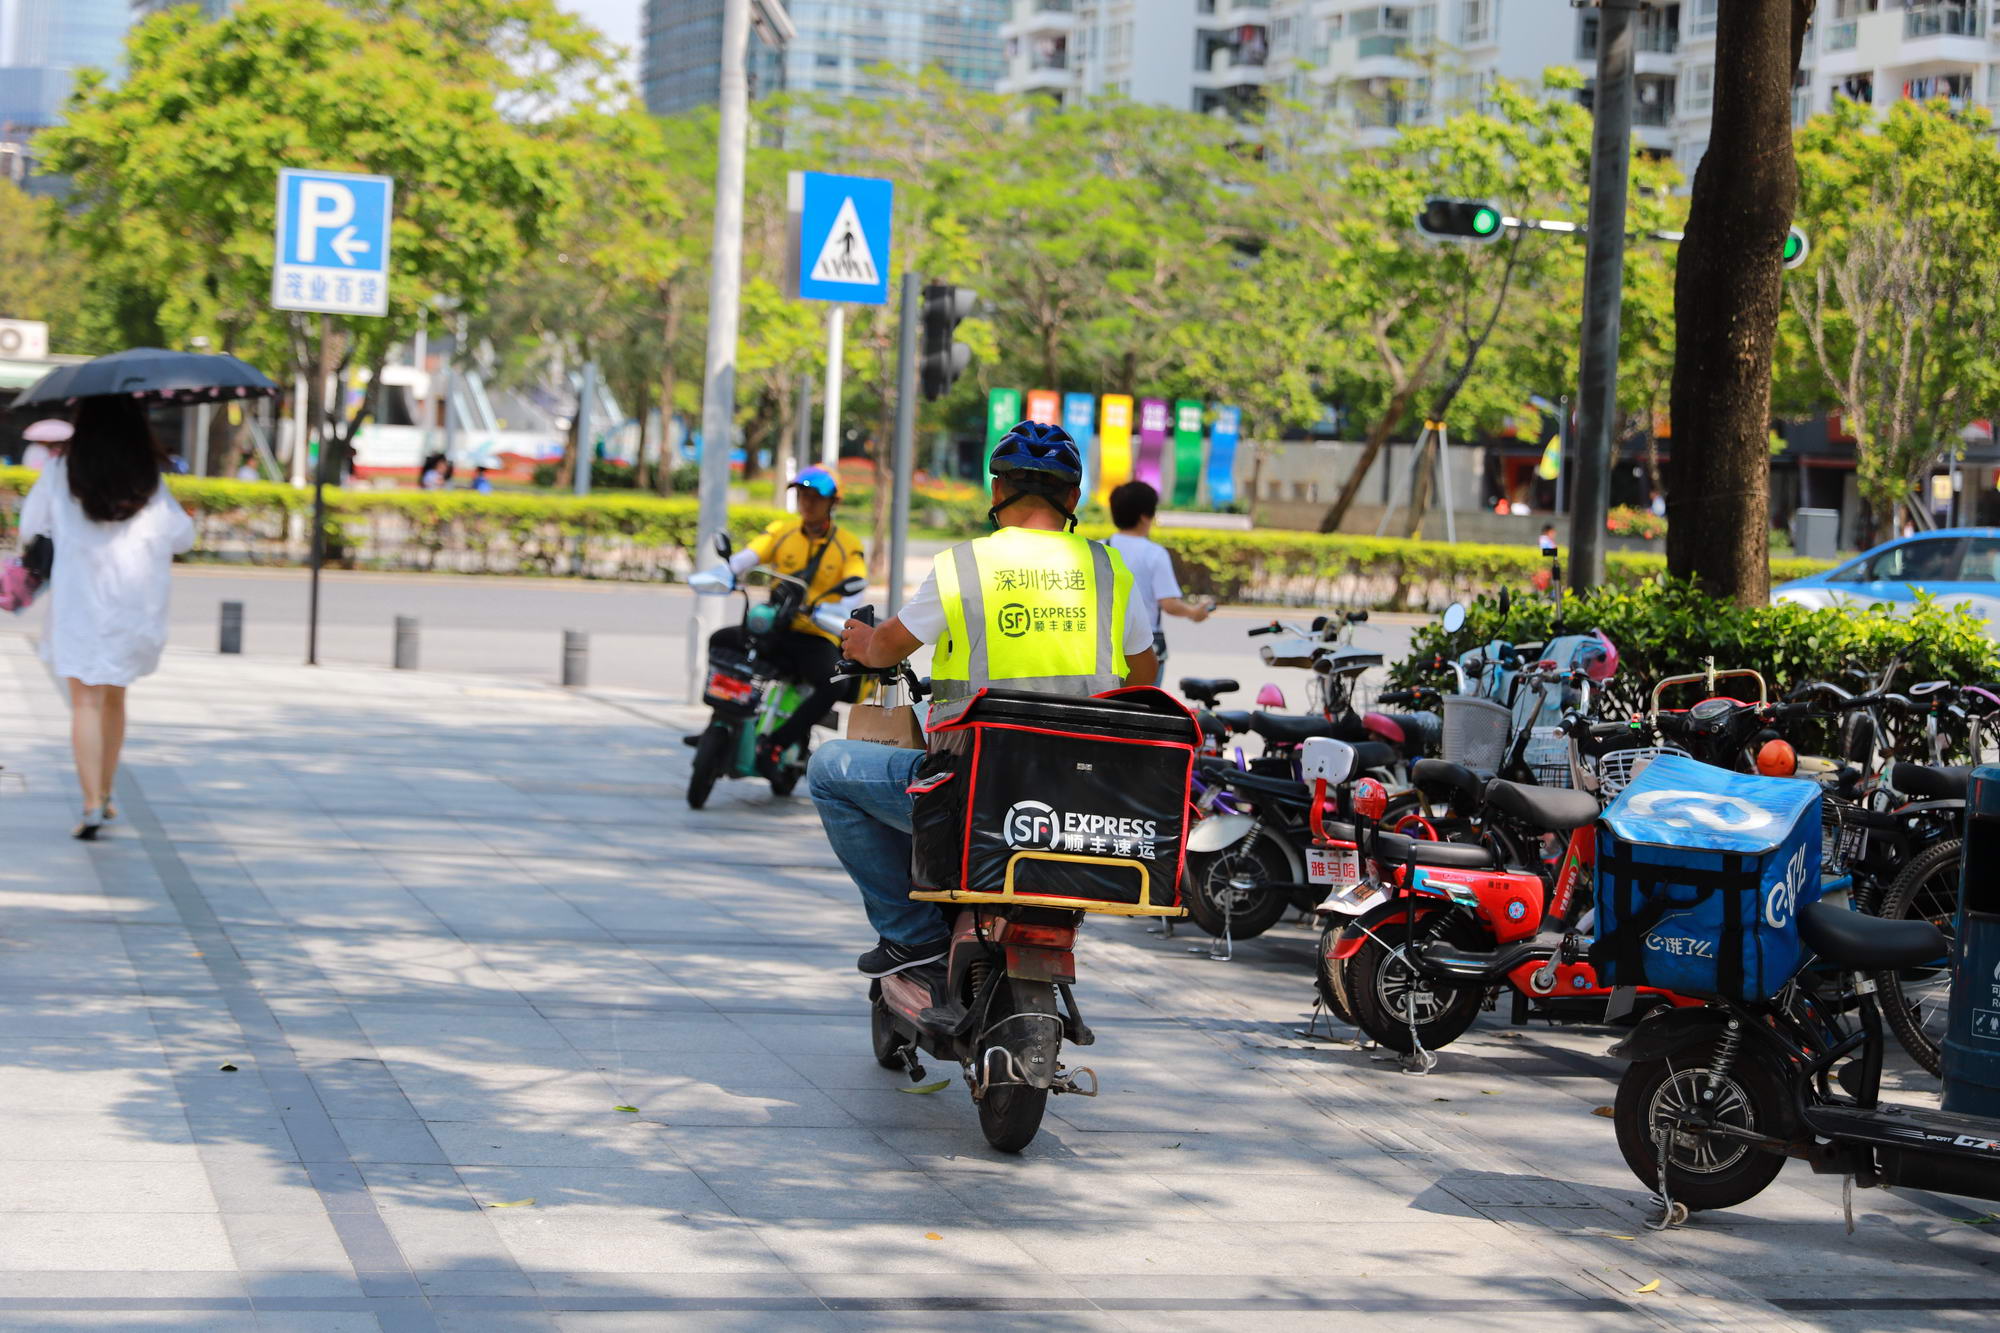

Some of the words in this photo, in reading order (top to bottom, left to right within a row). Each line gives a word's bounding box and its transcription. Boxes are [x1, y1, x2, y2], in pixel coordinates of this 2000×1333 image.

[296, 180, 356, 263] P
[993, 569, 1086, 592] 深圳快递
[1033, 607, 1087, 618] EXPRESS
[1033, 621, 1087, 632] 顺丰速运
[1064, 812, 1157, 839] EXPRESS
[1063, 833, 1156, 860] 顺丰速运
[1311, 861, 1356, 878] 雅马哈
